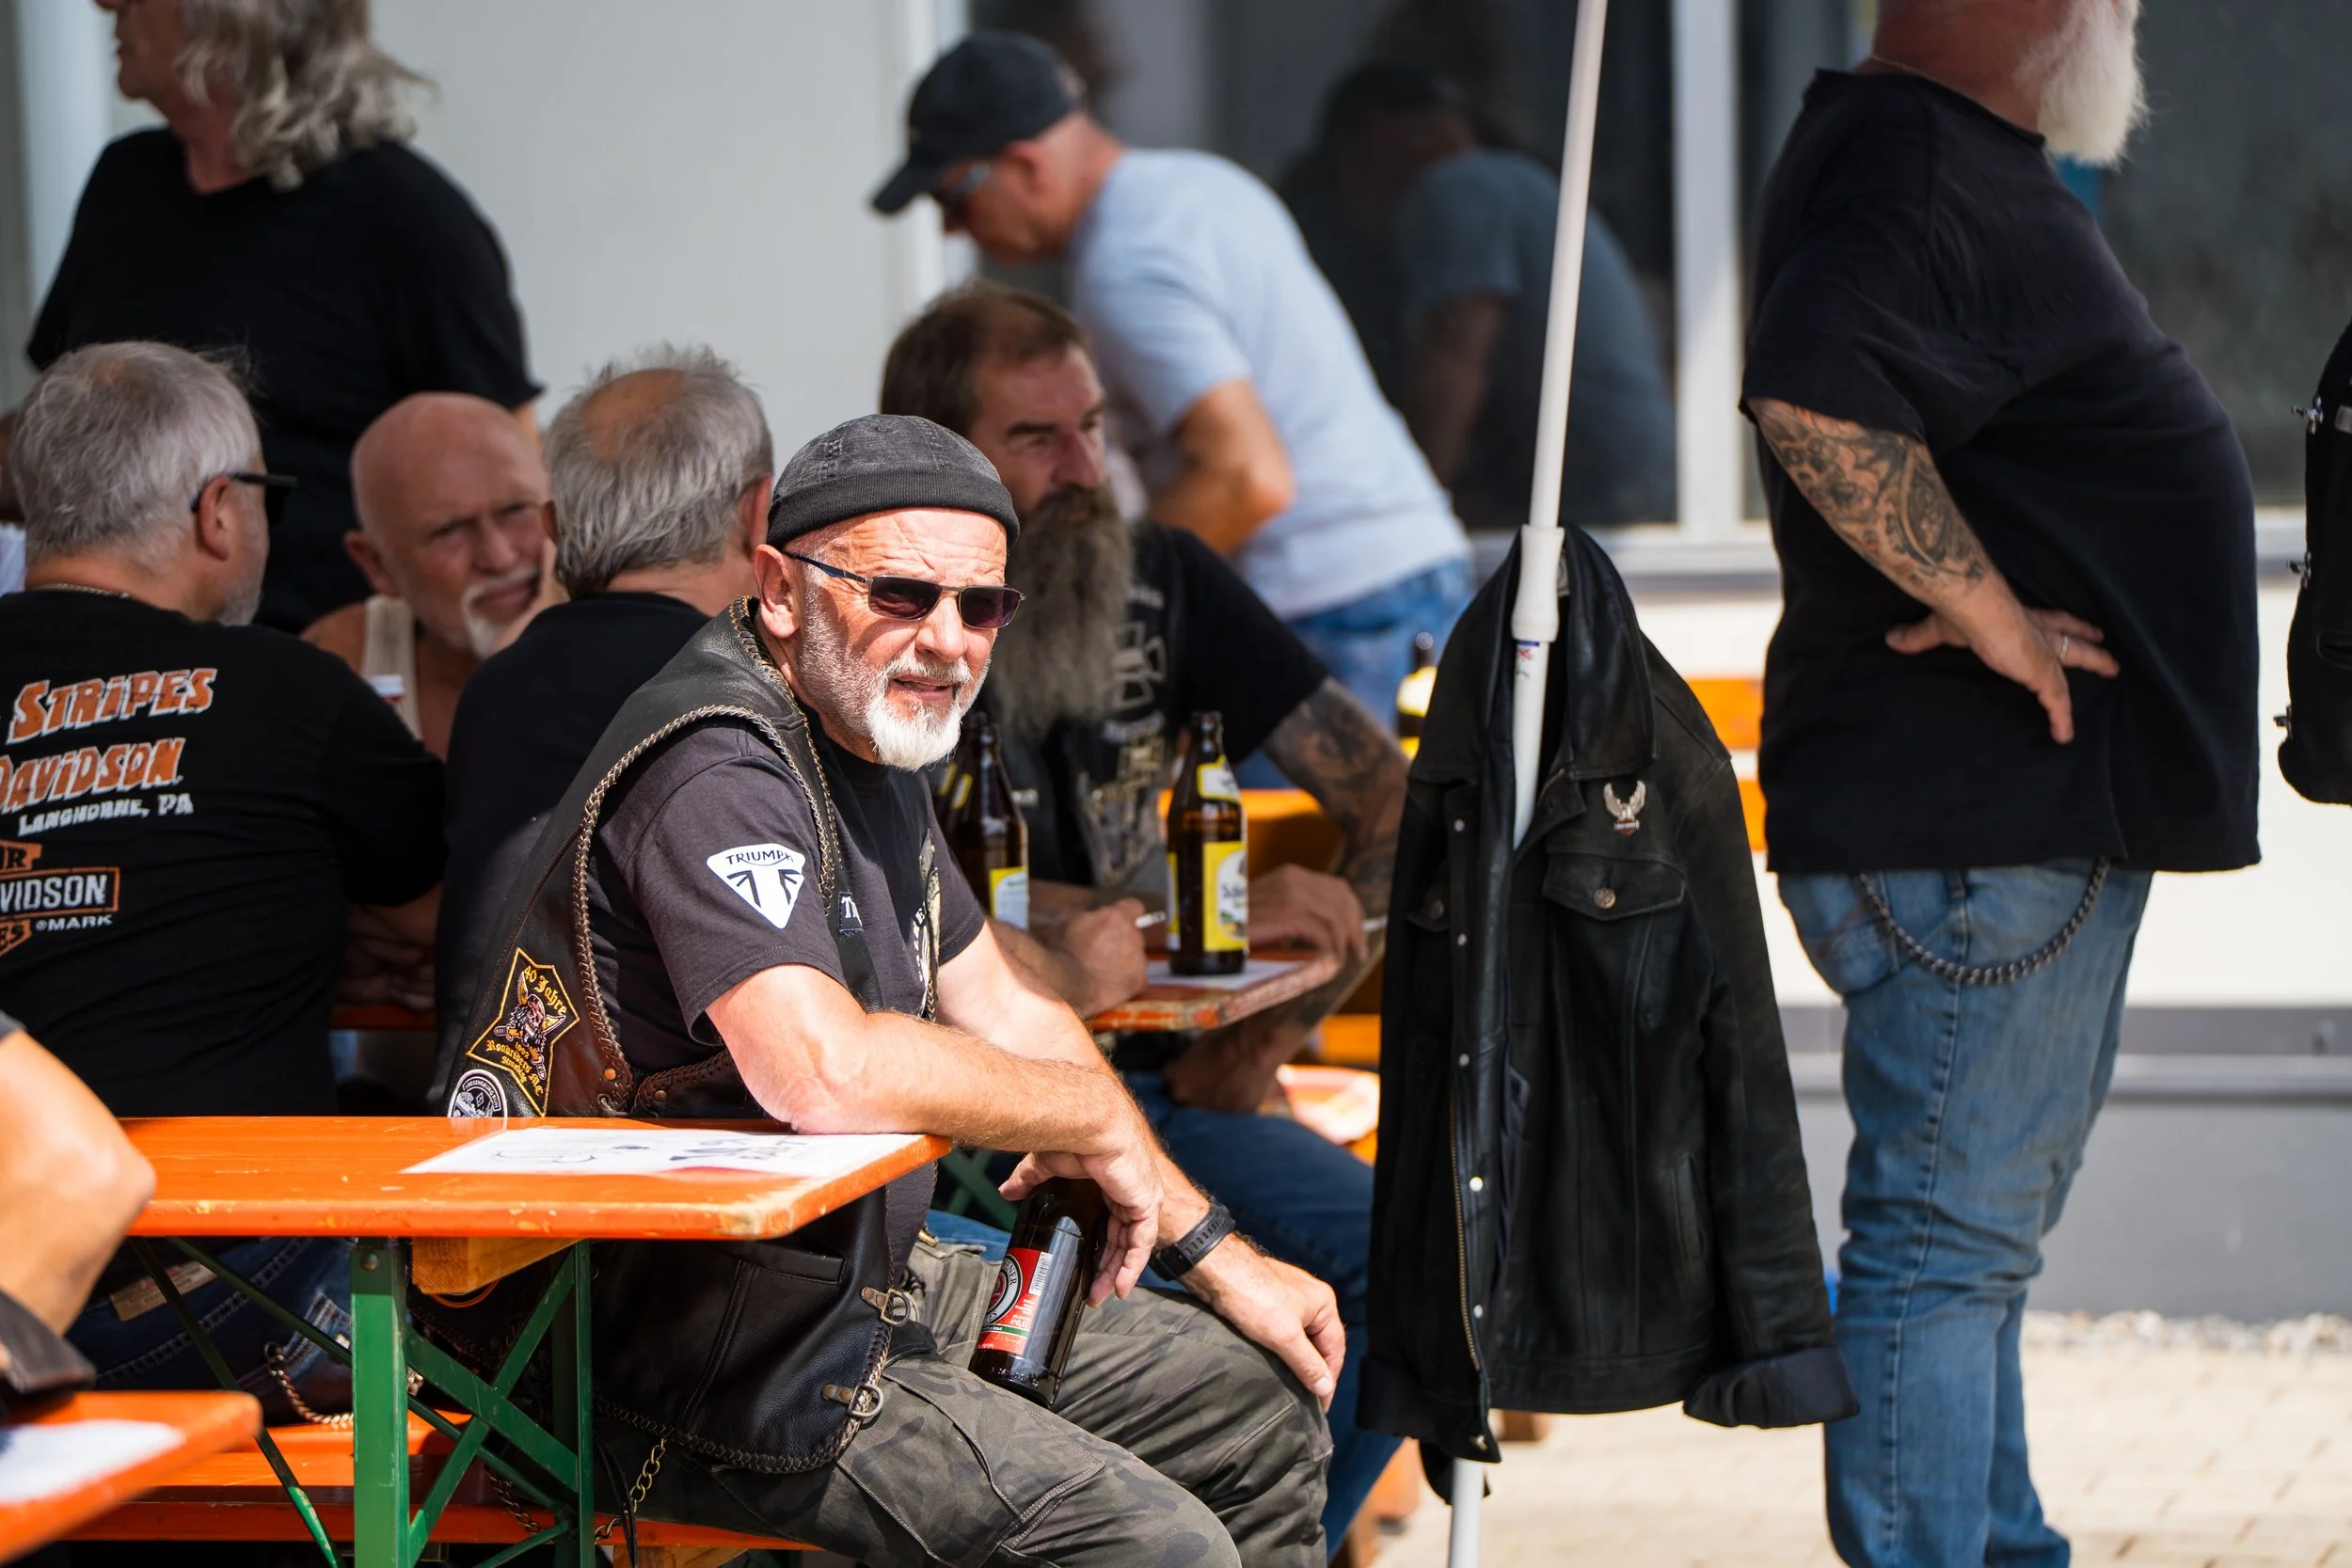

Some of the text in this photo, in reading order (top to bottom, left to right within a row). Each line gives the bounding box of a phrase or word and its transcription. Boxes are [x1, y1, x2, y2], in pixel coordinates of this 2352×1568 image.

[158, 793, 195, 816] PA
[725, 849, 795, 865] TRIUMPH
[523, 965, 567, 1016] 40 Jahre
[491, 1094, 500, 1108] RUN
